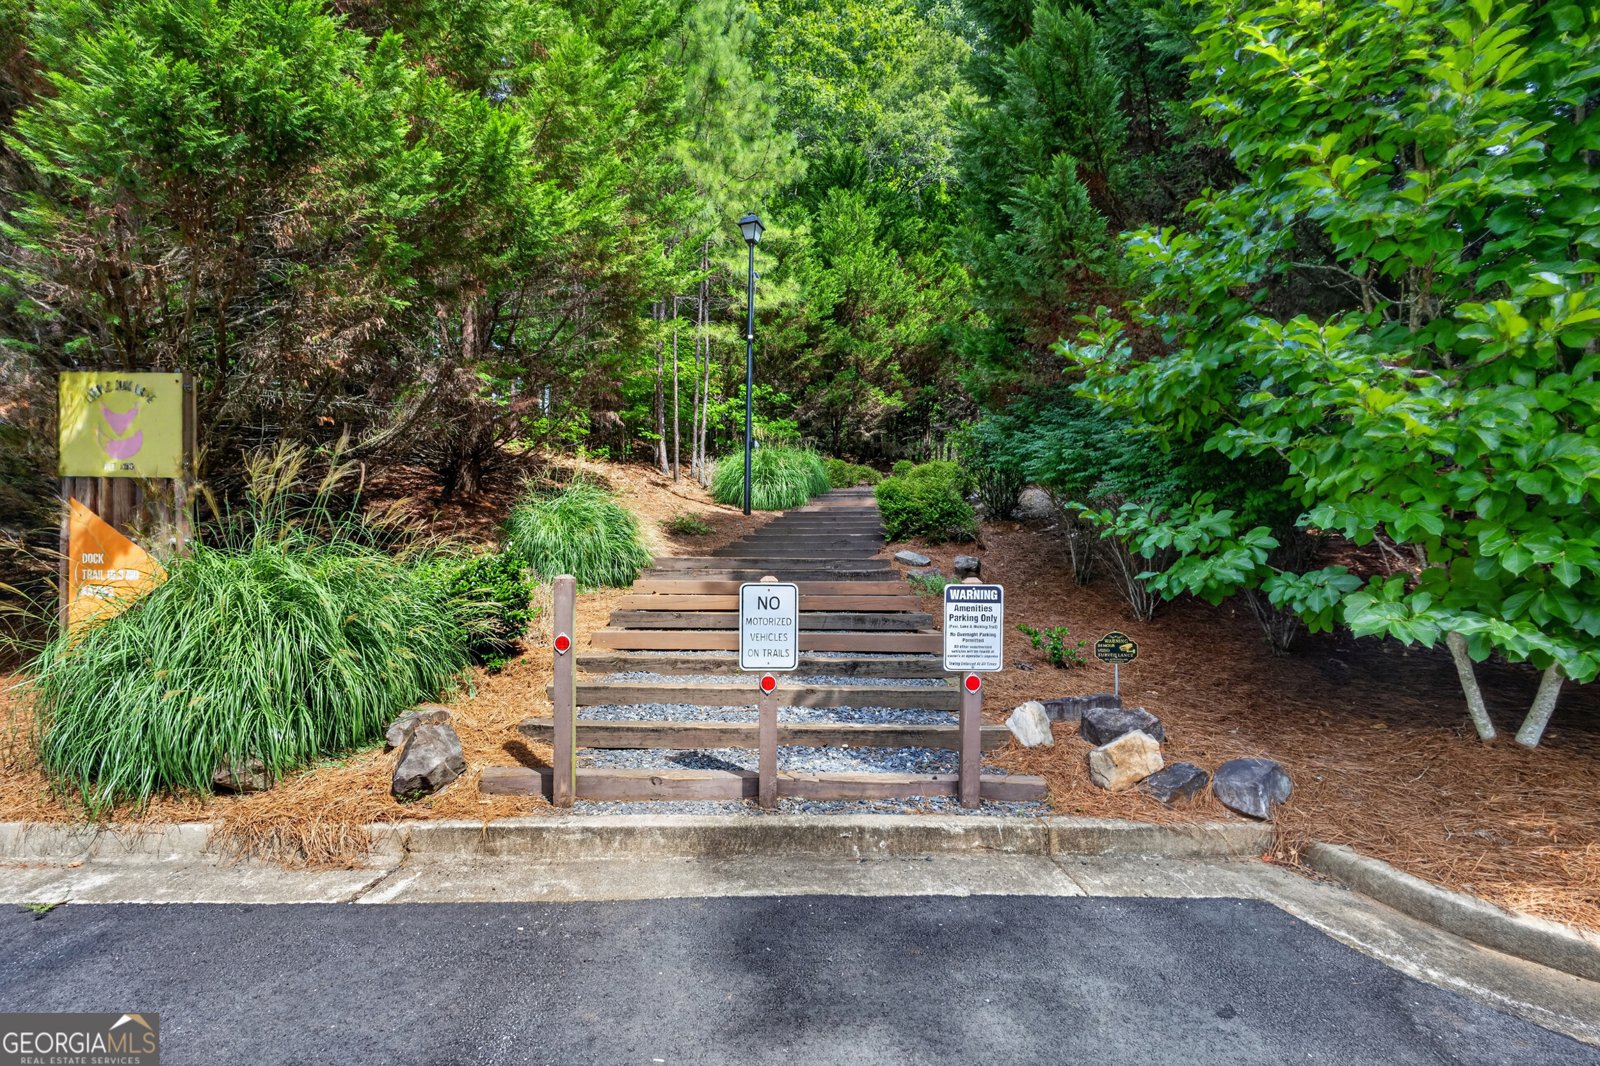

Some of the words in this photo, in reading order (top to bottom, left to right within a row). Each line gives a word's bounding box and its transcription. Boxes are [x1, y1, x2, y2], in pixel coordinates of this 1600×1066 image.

[82, 553, 104, 564] DOCK
[82, 569, 105, 580] TRAIL
[949, 589, 998, 600] WARNING
[757, 596, 780, 610] NO
[954, 604, 993, 612] Amenities
[745, 617, 792, 626] MOTORIZED
[949, 614, 979, 623] Parking
[980, 614, 998, 623] Only
[750, 632, 788, 641] VEHICLES
[747, 648, 760, 657] ON
[762, 648, 790, 657] TRAILS
